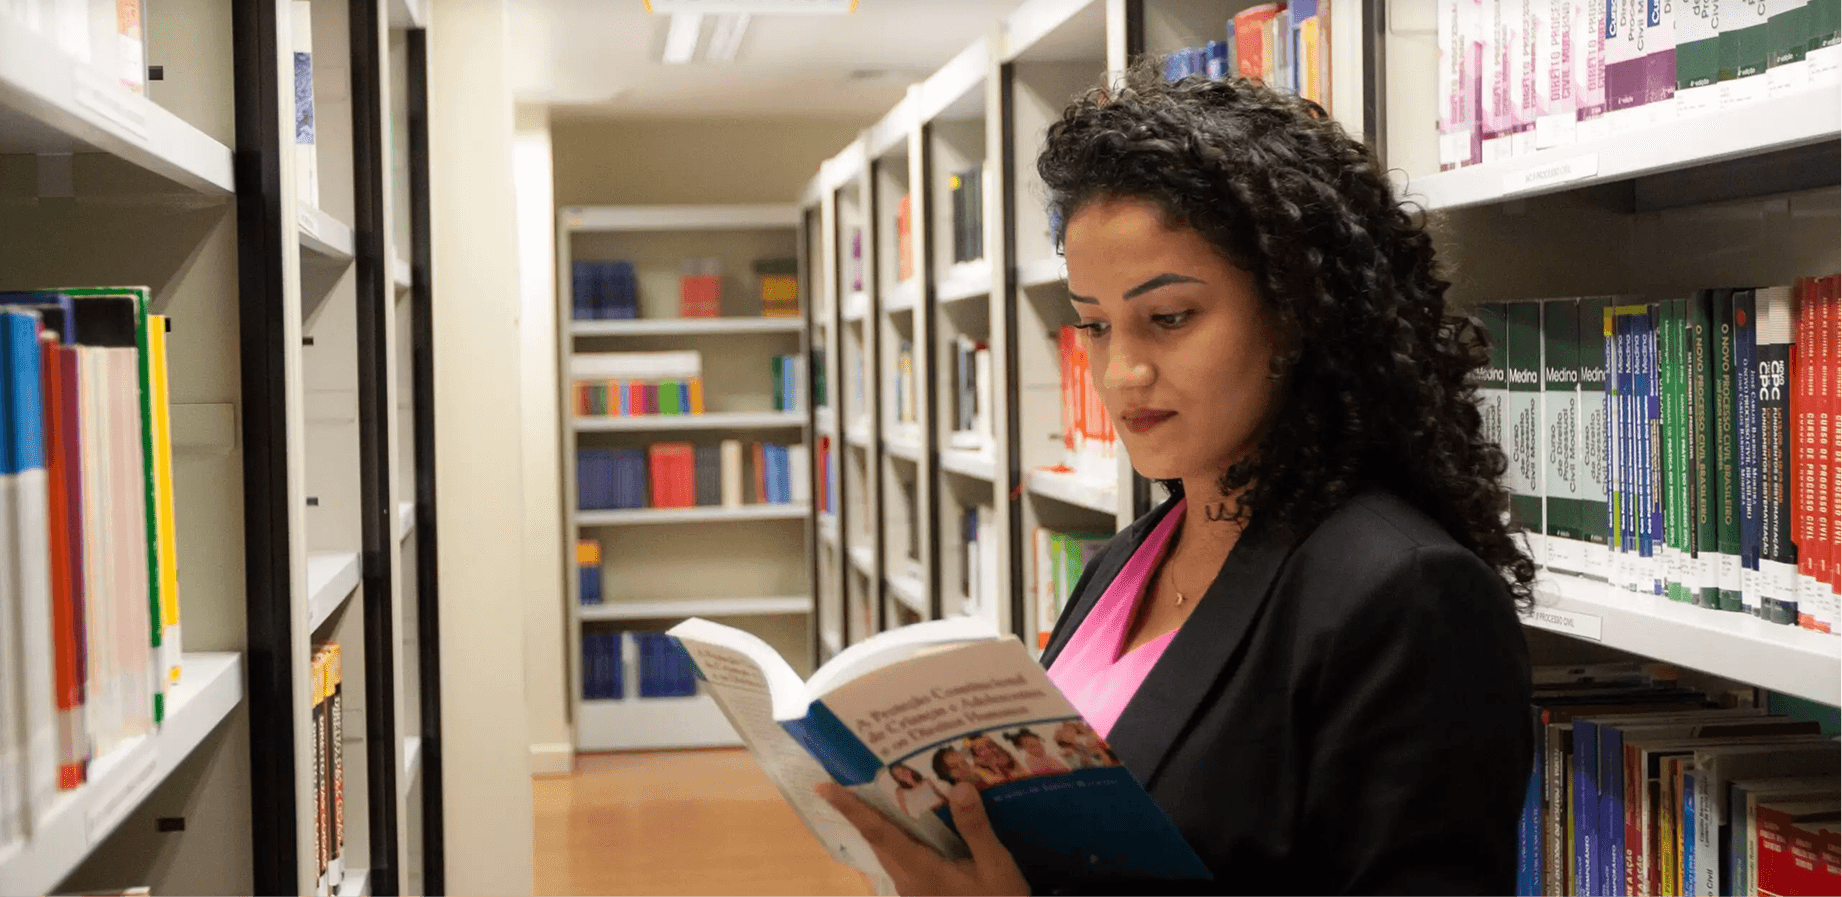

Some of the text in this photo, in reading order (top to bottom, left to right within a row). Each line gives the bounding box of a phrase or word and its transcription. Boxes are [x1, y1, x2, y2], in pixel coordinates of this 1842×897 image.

[1551, 51, 1560, 101] DIREITO
[1562, 68, 1570, 99] CIVIL
[1696, 325, 1702, 335] O
[1696, 337, 1704, 372] NOVO
[1510, 368, 1537, 383] Medina
[1546, 367, 1577, 382] Medina
[1759, 361, 1769, 401] CPC
[1771, 360, 1781, 400] CPC
[1697, 375, 1705, 431] PROCESSO
[1721, 324, 1732, 525] O NOVO PROCESSO CIVIL BRASILEIRO
[1520, 458, 1525, 475] de
[1557, 459, 1563, 477] de
[1590, 461, 1596, 479] de
[1835, 451, 1842, 463] DE
[1669, 472, 1673, 484] DO
[1682, 473, 1686, 485] DO
[1806, 412, 1814, 540] CURSO DE PROCESSO CIVIL
[1819, 413, 1828, 541] CURSO DE PROCESSO CIVIL
[1834, 467, 1842, 516] PROCESSO
[1699, 464, 1707, 524] BRASILEIRO
[1772, 483, 1780, 557] SISTEMATIZAÇÃO
[1540, 612, 1574, 627] PROCESSO CIVIL
[1554, 823, 1560, 836] DO
[1625, 849, 1633, 884] A AÇÃO
[1637, 881, 1644, 889] A
